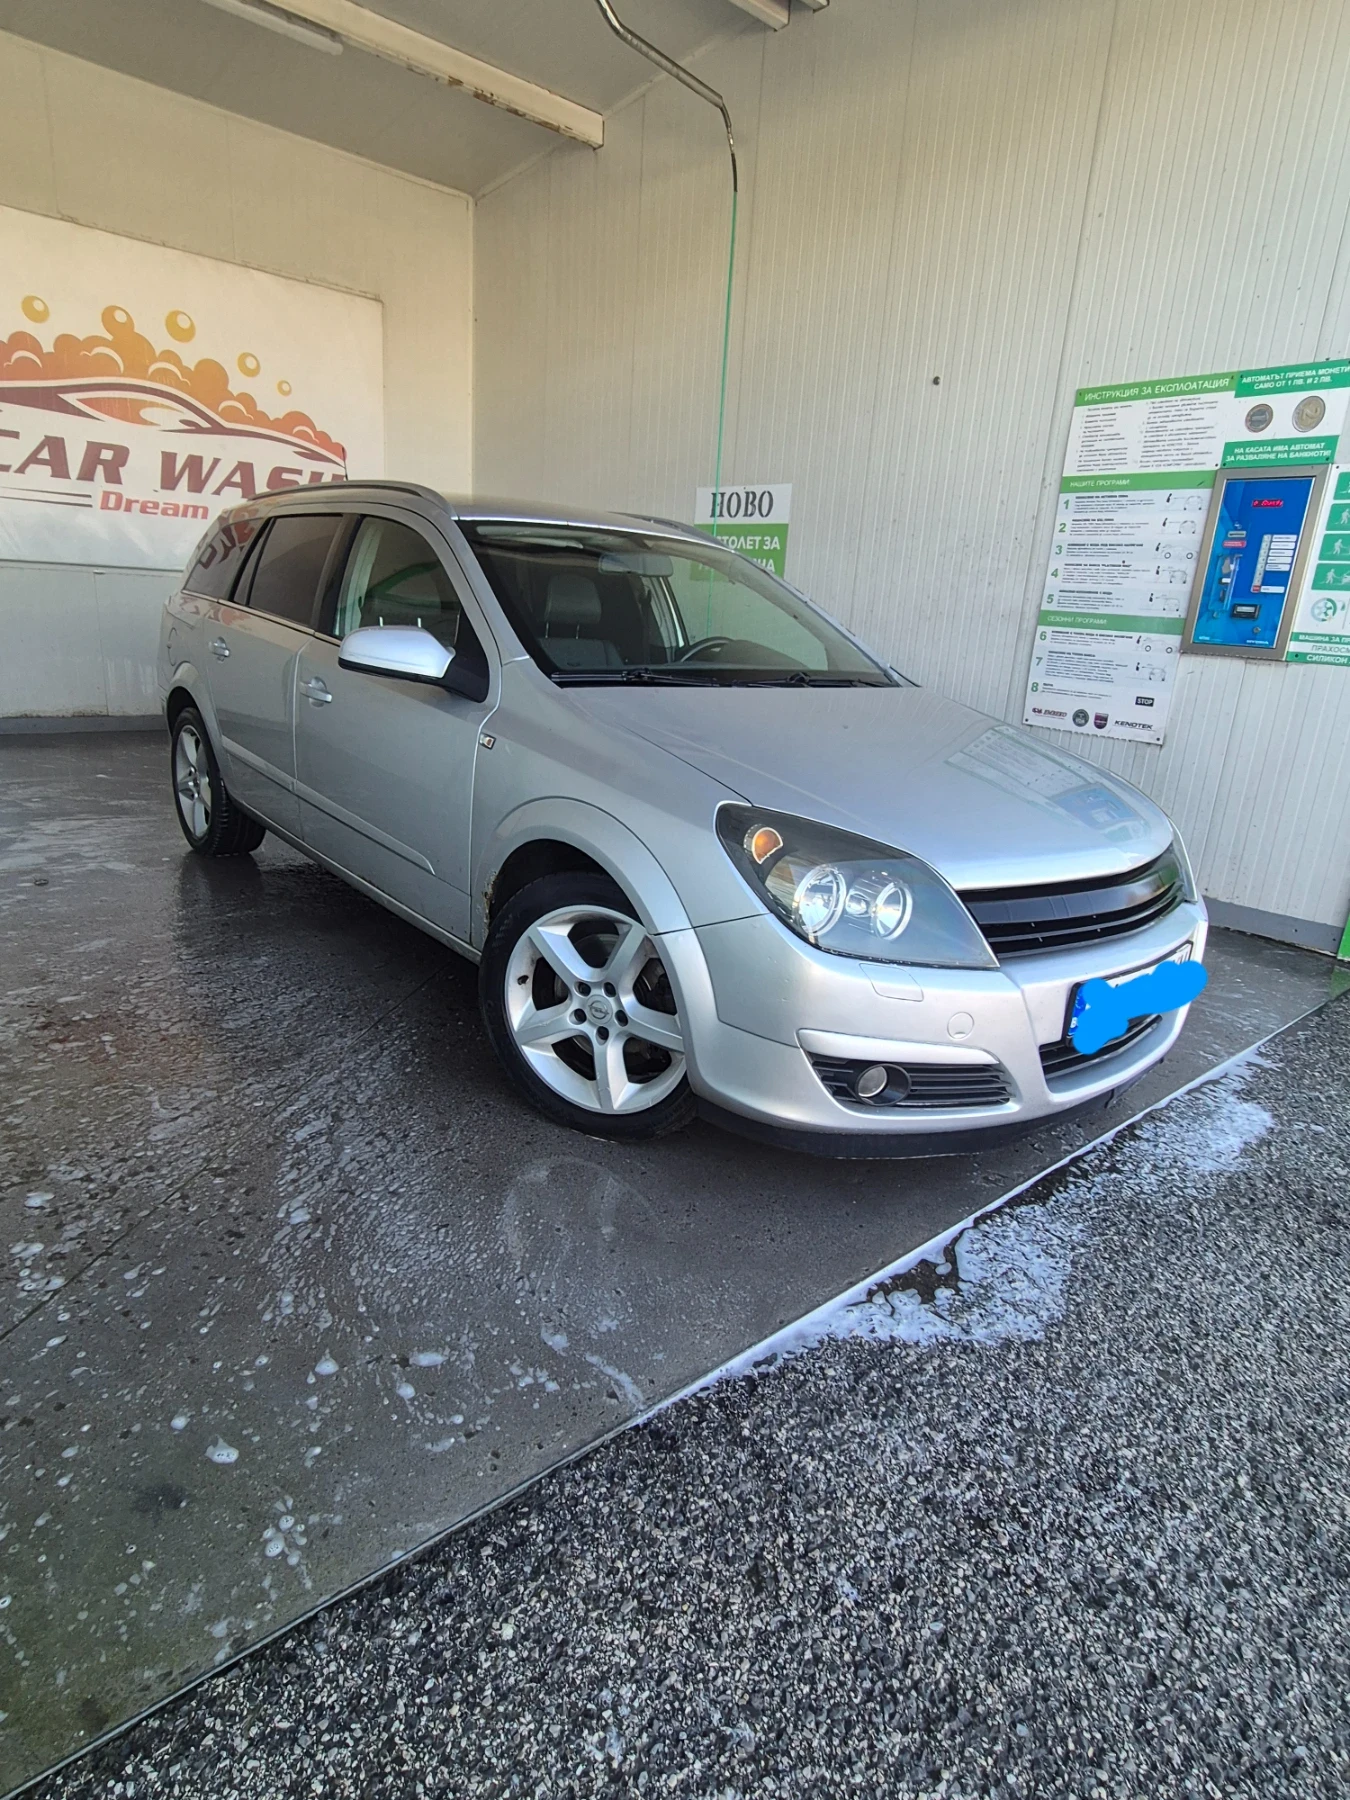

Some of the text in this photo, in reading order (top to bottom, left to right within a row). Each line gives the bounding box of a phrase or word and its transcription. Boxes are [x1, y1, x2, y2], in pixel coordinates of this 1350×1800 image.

[1241, 372, 1284, 384] АВТОМАТЪТ
[1286, 370, 1316, 379] ПРИЕМА
[1084, 378, 1230, 401] ИНСТРУКЦИЯ ЗА ЕКСПЛОАТАЦИЯ
[1253, 381, 1275, 389] САМО
[100, 490, 209, 519] Dream
[709, 490, 774, 518] НОВО
[1063, 498, 1070, 510] 1
[1058, 522, 1067, 533] 2
[763, 535, 780, 550] ЗА
[1055, 545, 1063, 555] 3
[1051, 568, 1059, 578] 4
[1046, 594, 1054, 604] 5
[1039, 631, 1047, 641] 6
[1035, 656, 1043, 666] 7
[1031, 681, 1039, 692] 8
[1136, 697, 1153, 705] STOP
[1114, 719, 1153, 731] KENOTEK
